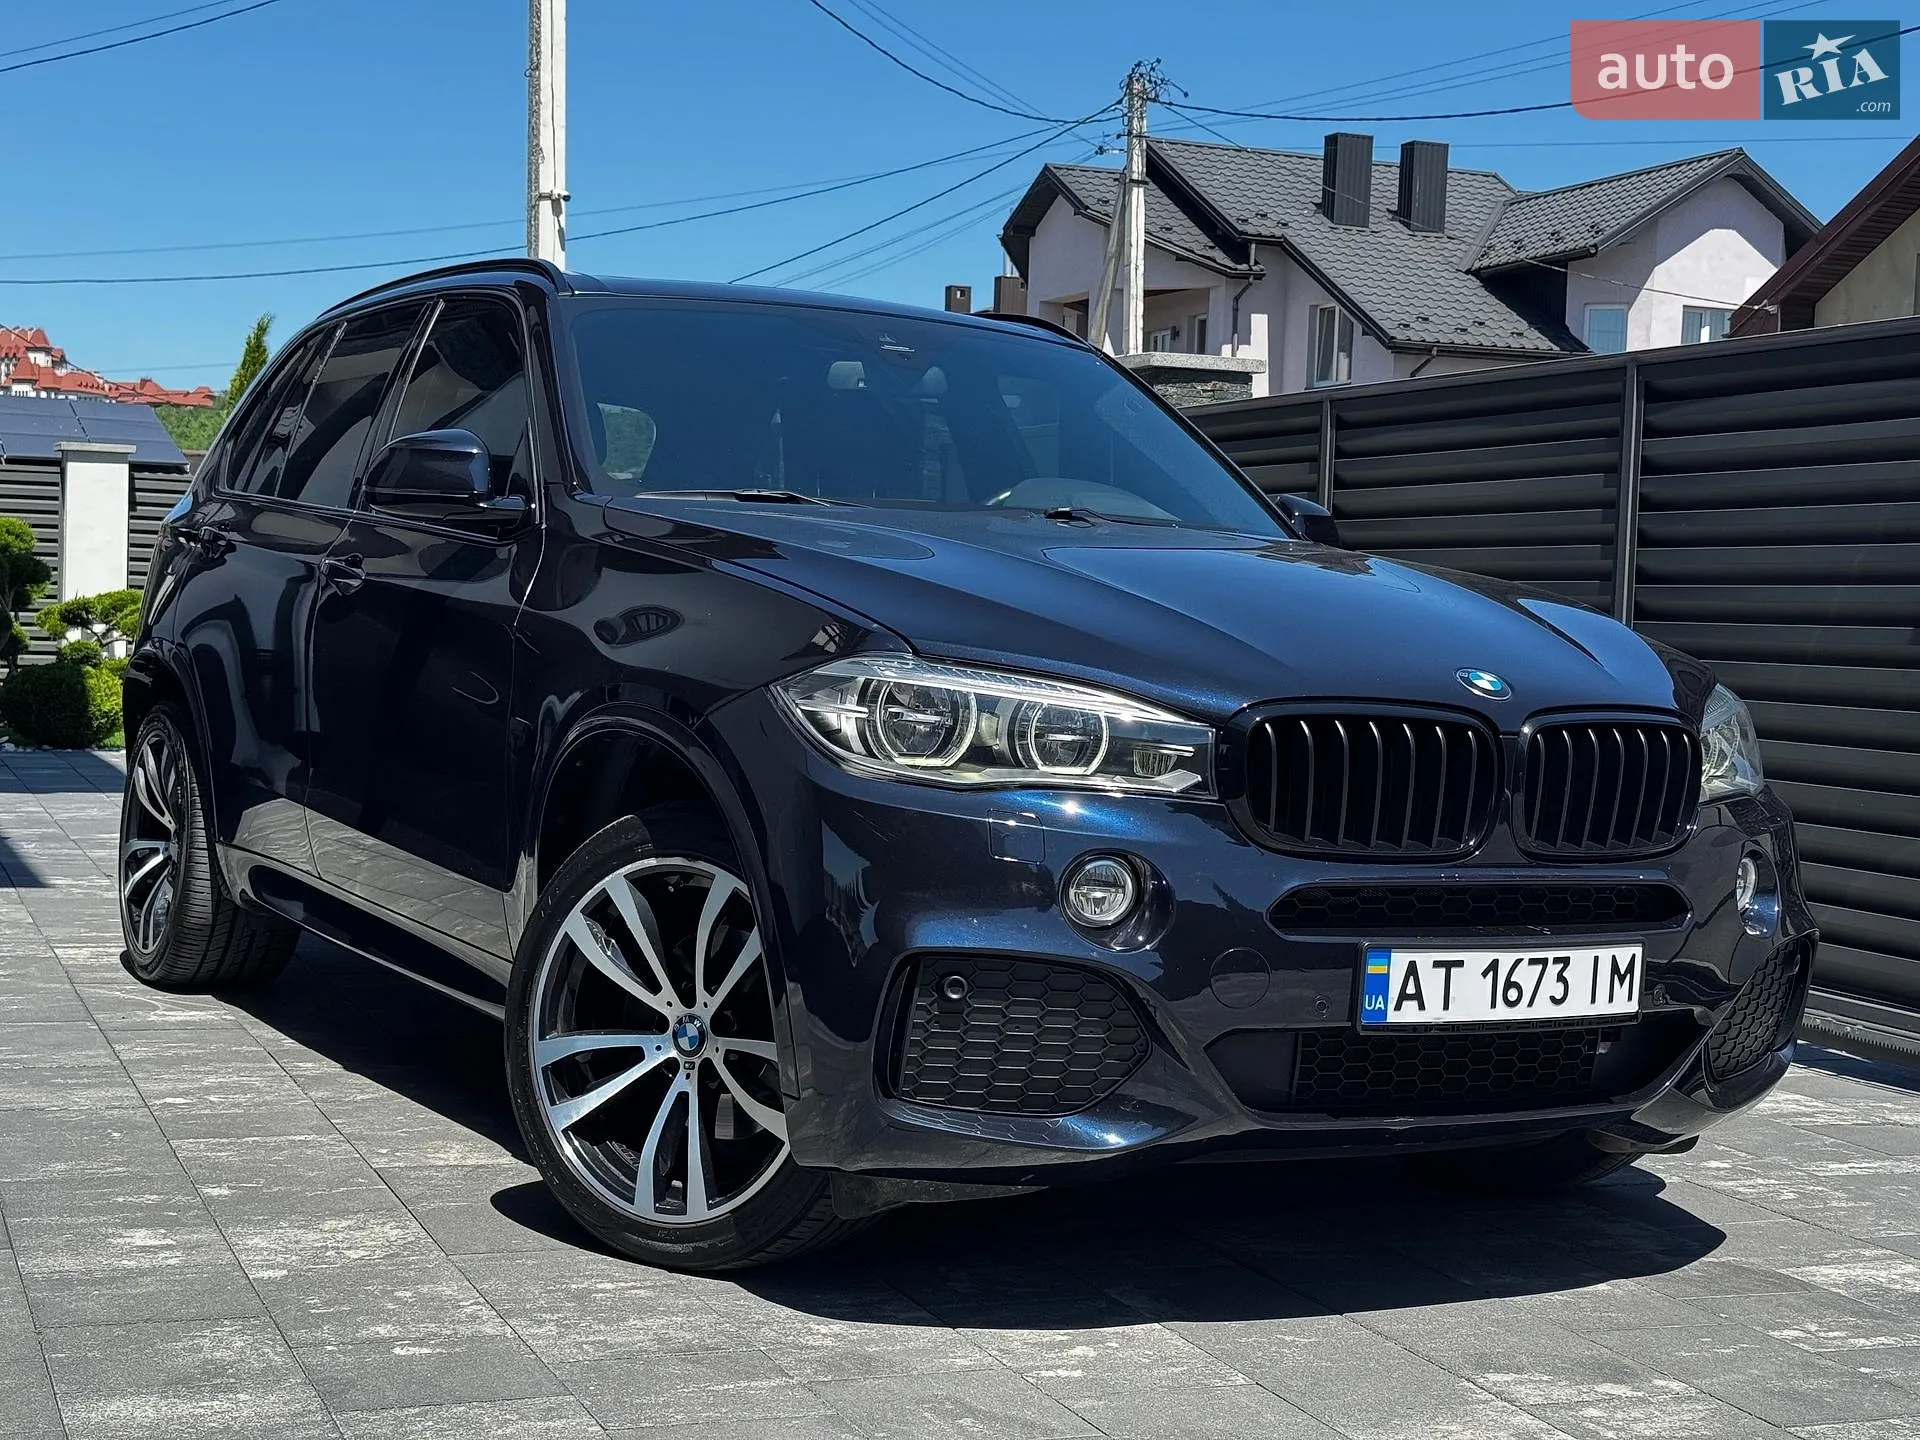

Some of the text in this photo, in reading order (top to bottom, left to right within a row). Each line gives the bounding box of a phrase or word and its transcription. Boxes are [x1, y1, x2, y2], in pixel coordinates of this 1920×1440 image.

[1394, 953, 1637, 1012] AT 1673 IM
[1365, 995, 1385, 1011] UA
